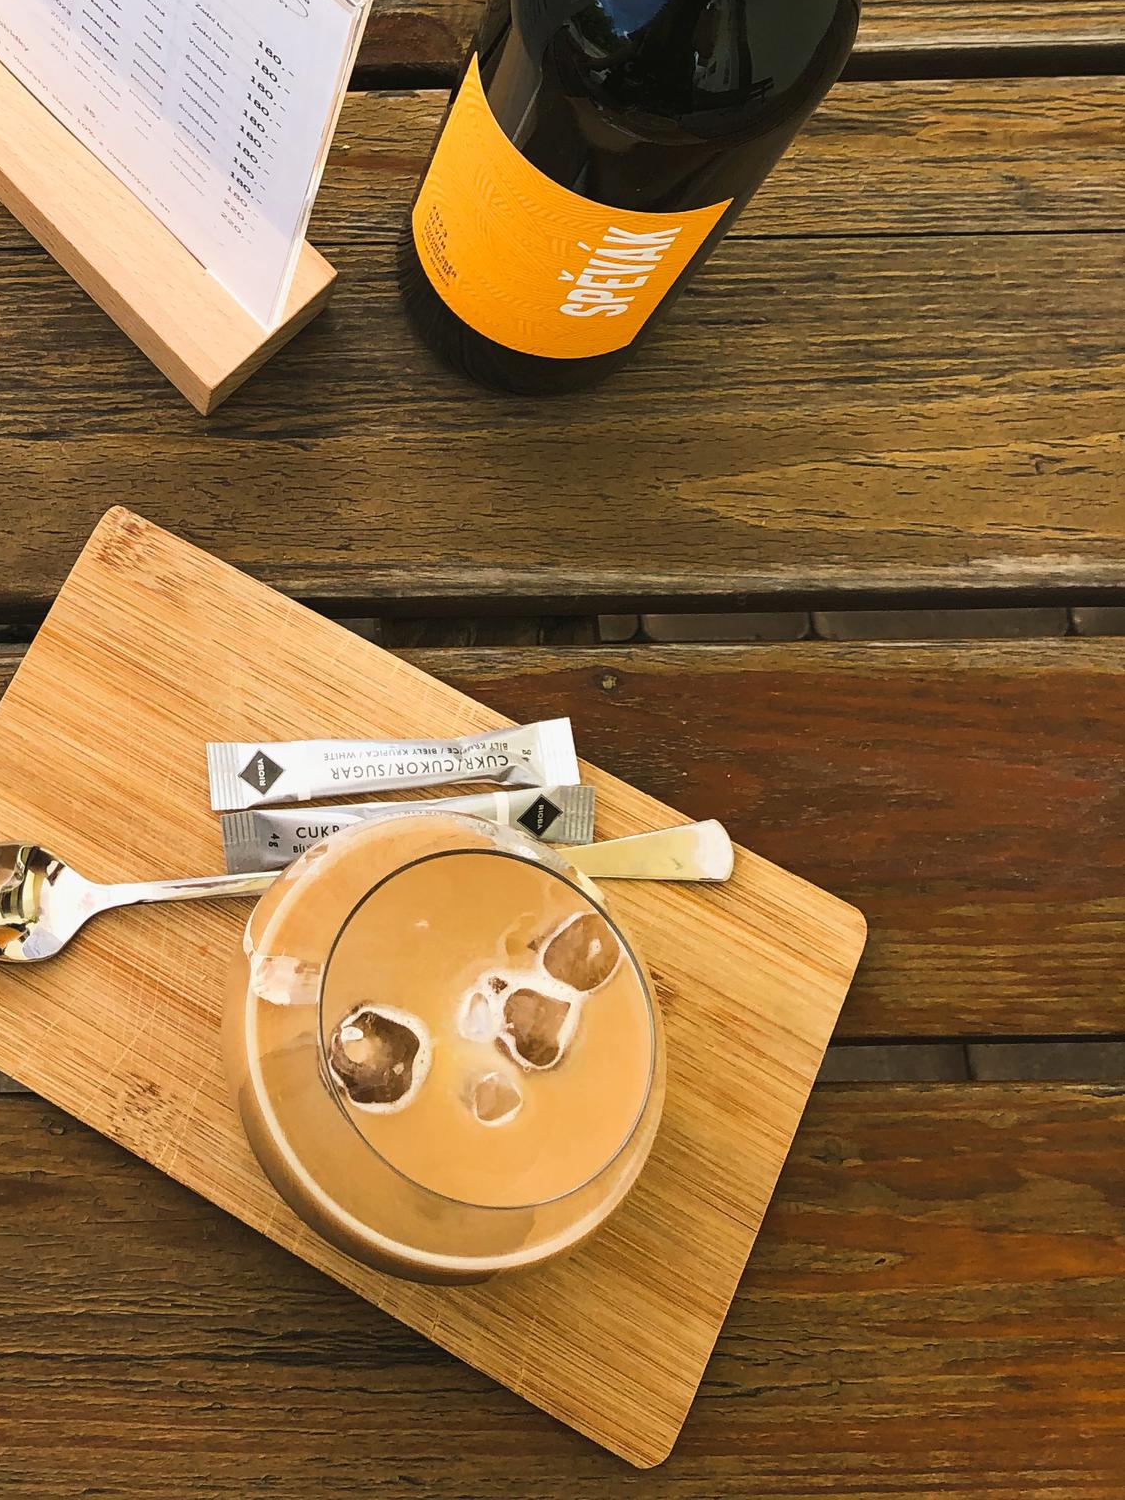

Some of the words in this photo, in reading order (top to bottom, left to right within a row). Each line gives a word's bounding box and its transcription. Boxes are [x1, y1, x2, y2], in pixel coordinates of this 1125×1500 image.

[258, 40, 294, 76] 180,-
[255, 58, 290, 93] 180,-
[251, 76, 285, 111] 180,-
[243, 109, 276, 143] 180,-
[248, 93, 281, 128] 180,-
[237, 142, 268, 174] 180,-
[240, 125, 273, 158] 180,-
[231, 172, 262, 204] 180,-
[234, 157, 265, 190] 180,-
[558, 226, 683, 317] SPĚVÁK
[257, 758, 267, 787] RIOBA
[323, 752, 356, 762] WHITE
[536, 804, 545, 830] RIOBA
